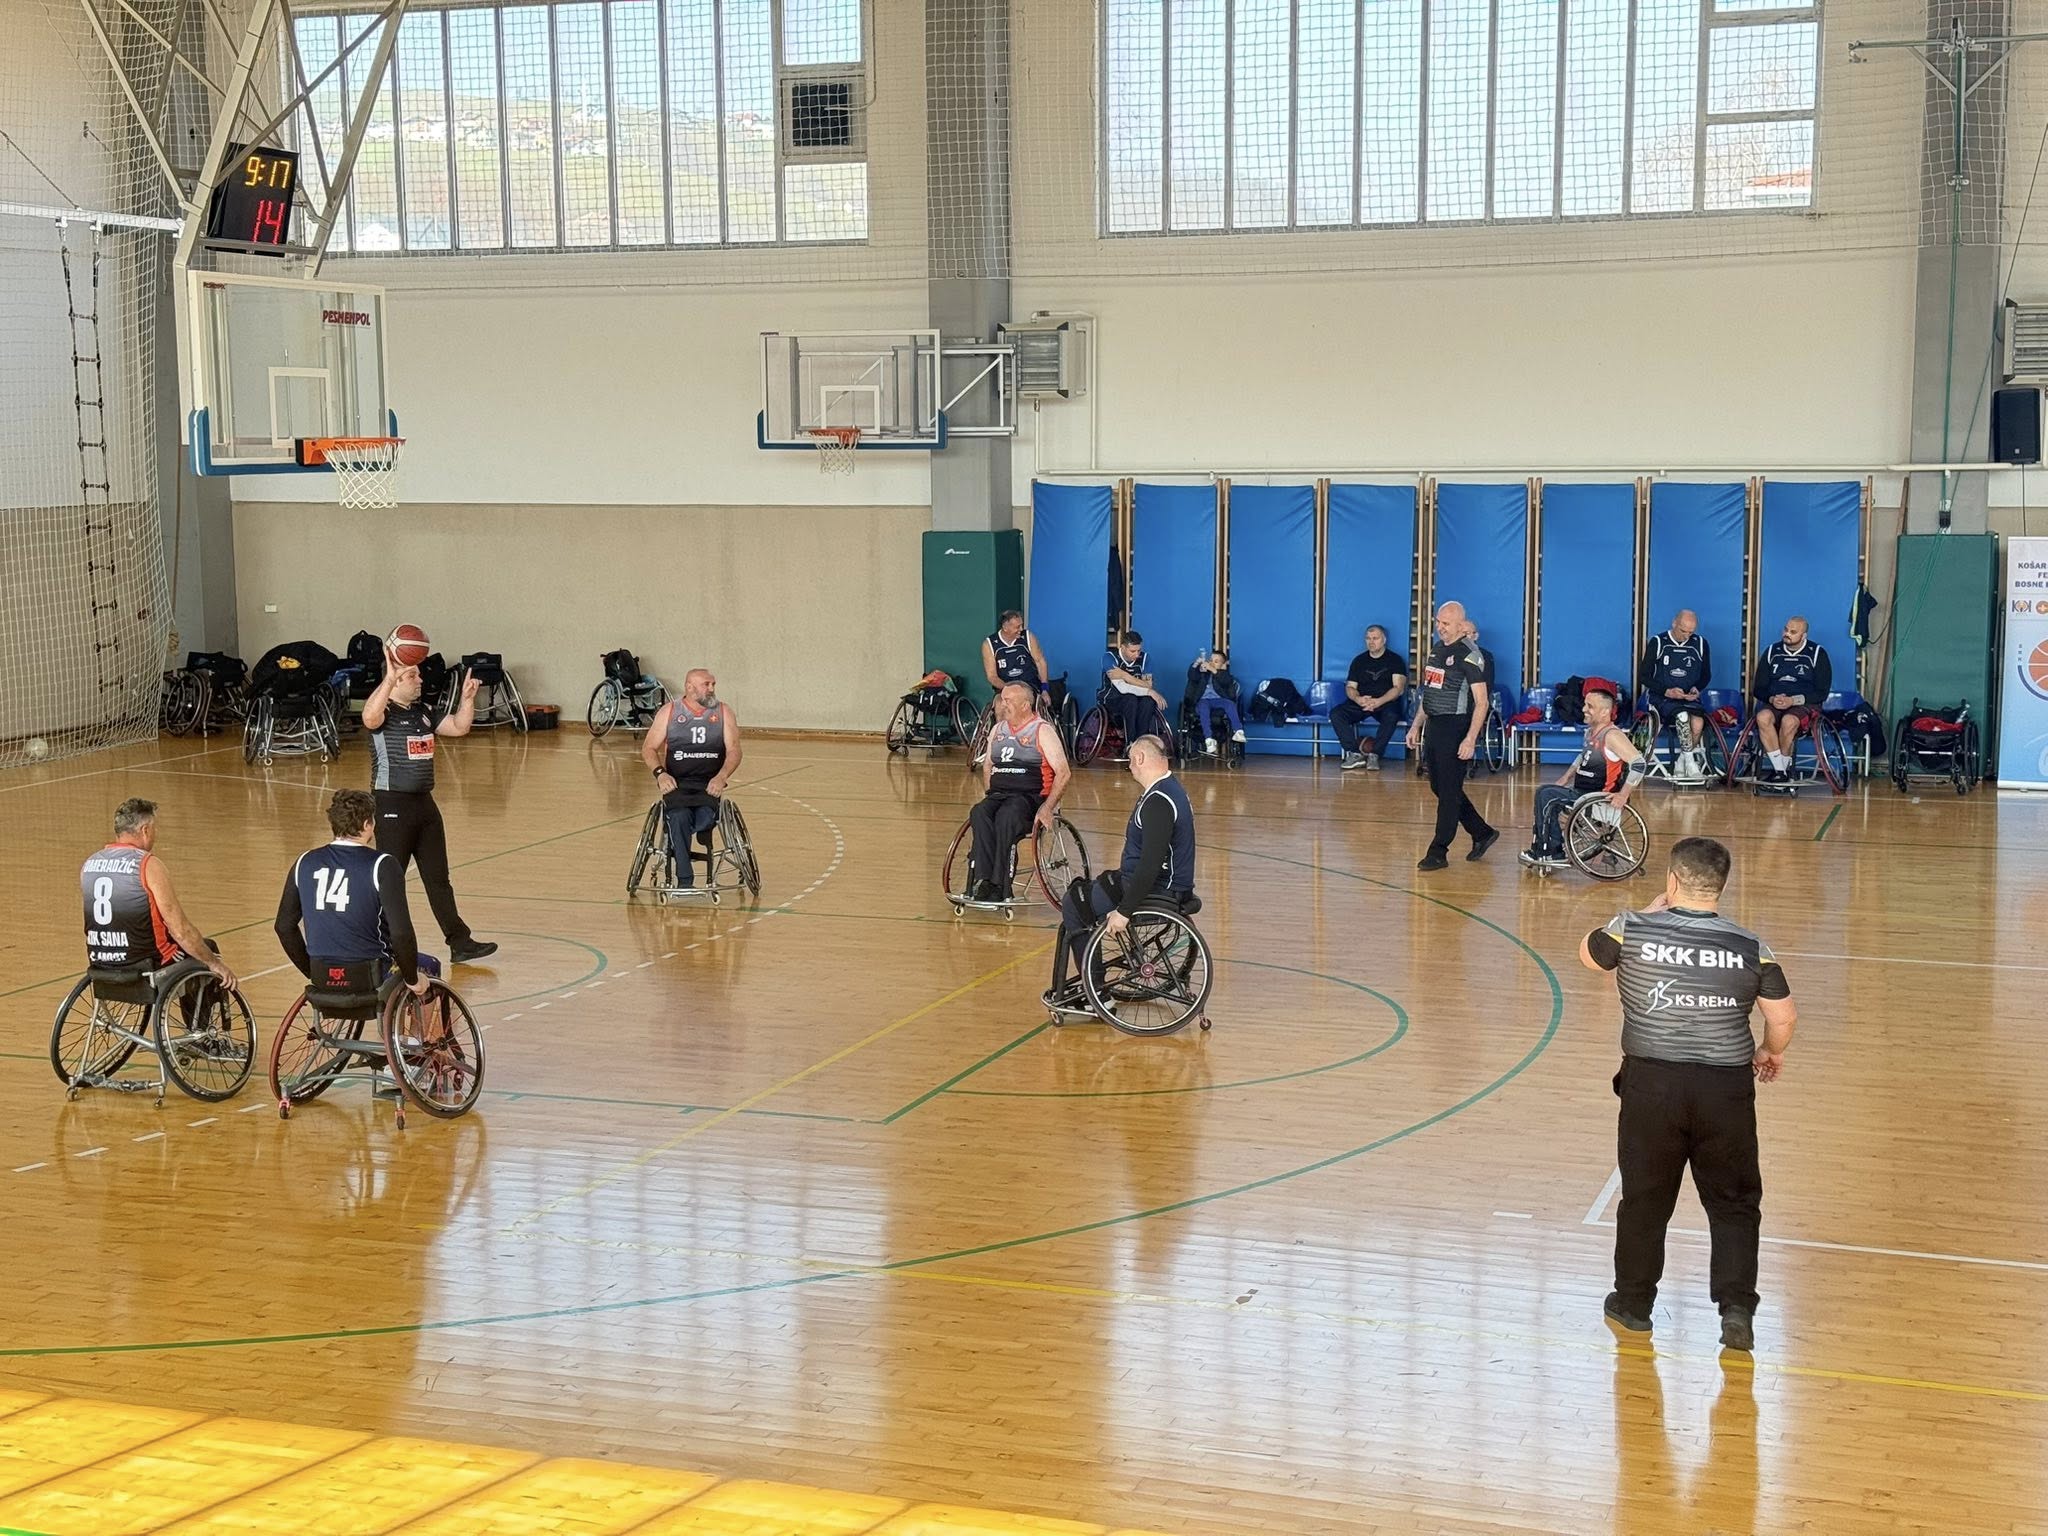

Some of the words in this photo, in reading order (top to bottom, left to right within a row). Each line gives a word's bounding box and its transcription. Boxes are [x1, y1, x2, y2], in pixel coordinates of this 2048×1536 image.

[245, 156, 291, 189] 9:17
[252, 200, 286, 245] 14
[322, 310, 371, 327] PESMENPOL
[998, 659, 1007, 668] 15
[1772, 664, 1779, 674] 7
[690, 726, 706, 744] 13
[1000, 746, 1015, 763] 12
[313, 867, 350, 912] 14
[93, 876, 114, 926] 8
[100, 931, 129, 947] SANA
[1640, 942, 1695, 967] SKK
[1698, 949, 1744, 969] BIH
[1675, 994, 1695, 1007] KS
[1698, 995, 1737, 1008] REHA
